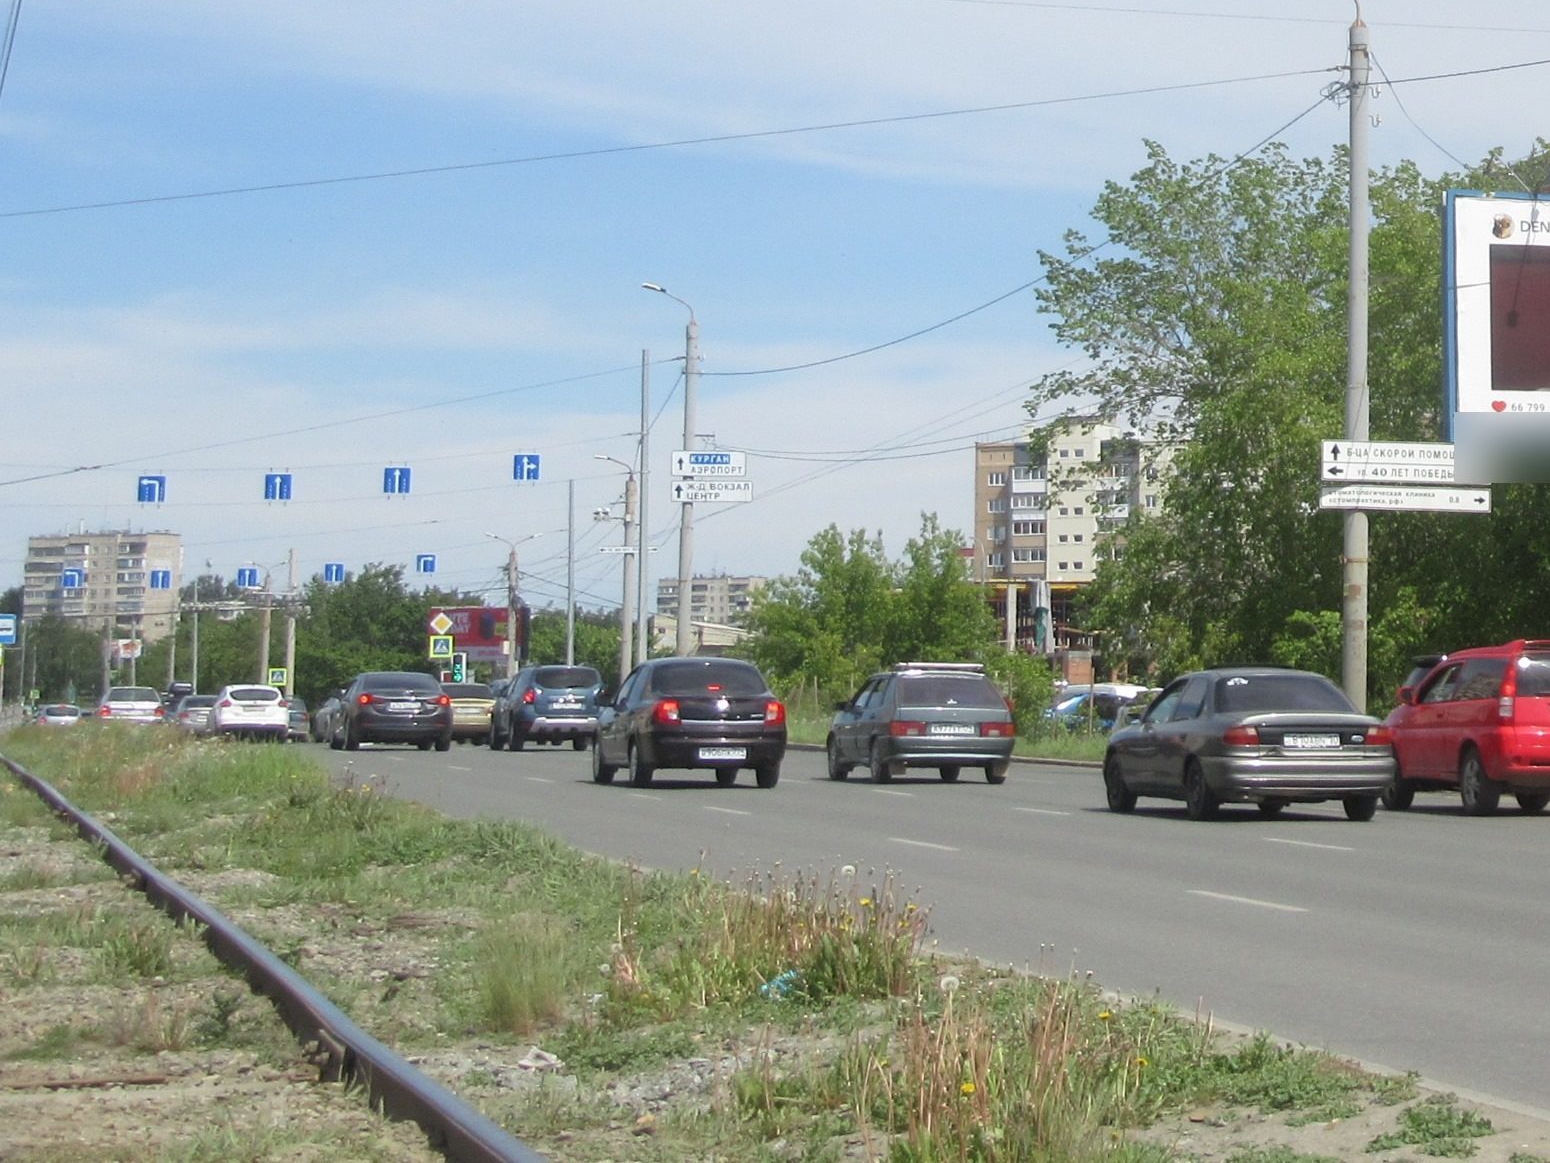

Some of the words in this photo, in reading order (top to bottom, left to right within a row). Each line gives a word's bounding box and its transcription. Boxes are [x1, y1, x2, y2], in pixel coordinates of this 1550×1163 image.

[1346, 447, 1369, 458] Б-ЦА
[690, 455, 729, 463] КУРГАН
[690, 466, 742, 474] АЭРОПОРТ
[1371, 468, 1387, 477] 40
[1391, 468, 1408, 477] ЛЕТ
[710, 483, 750, 491] ВОКЗАЛ
[686, 492, 720, 500] ЦЕНТР
